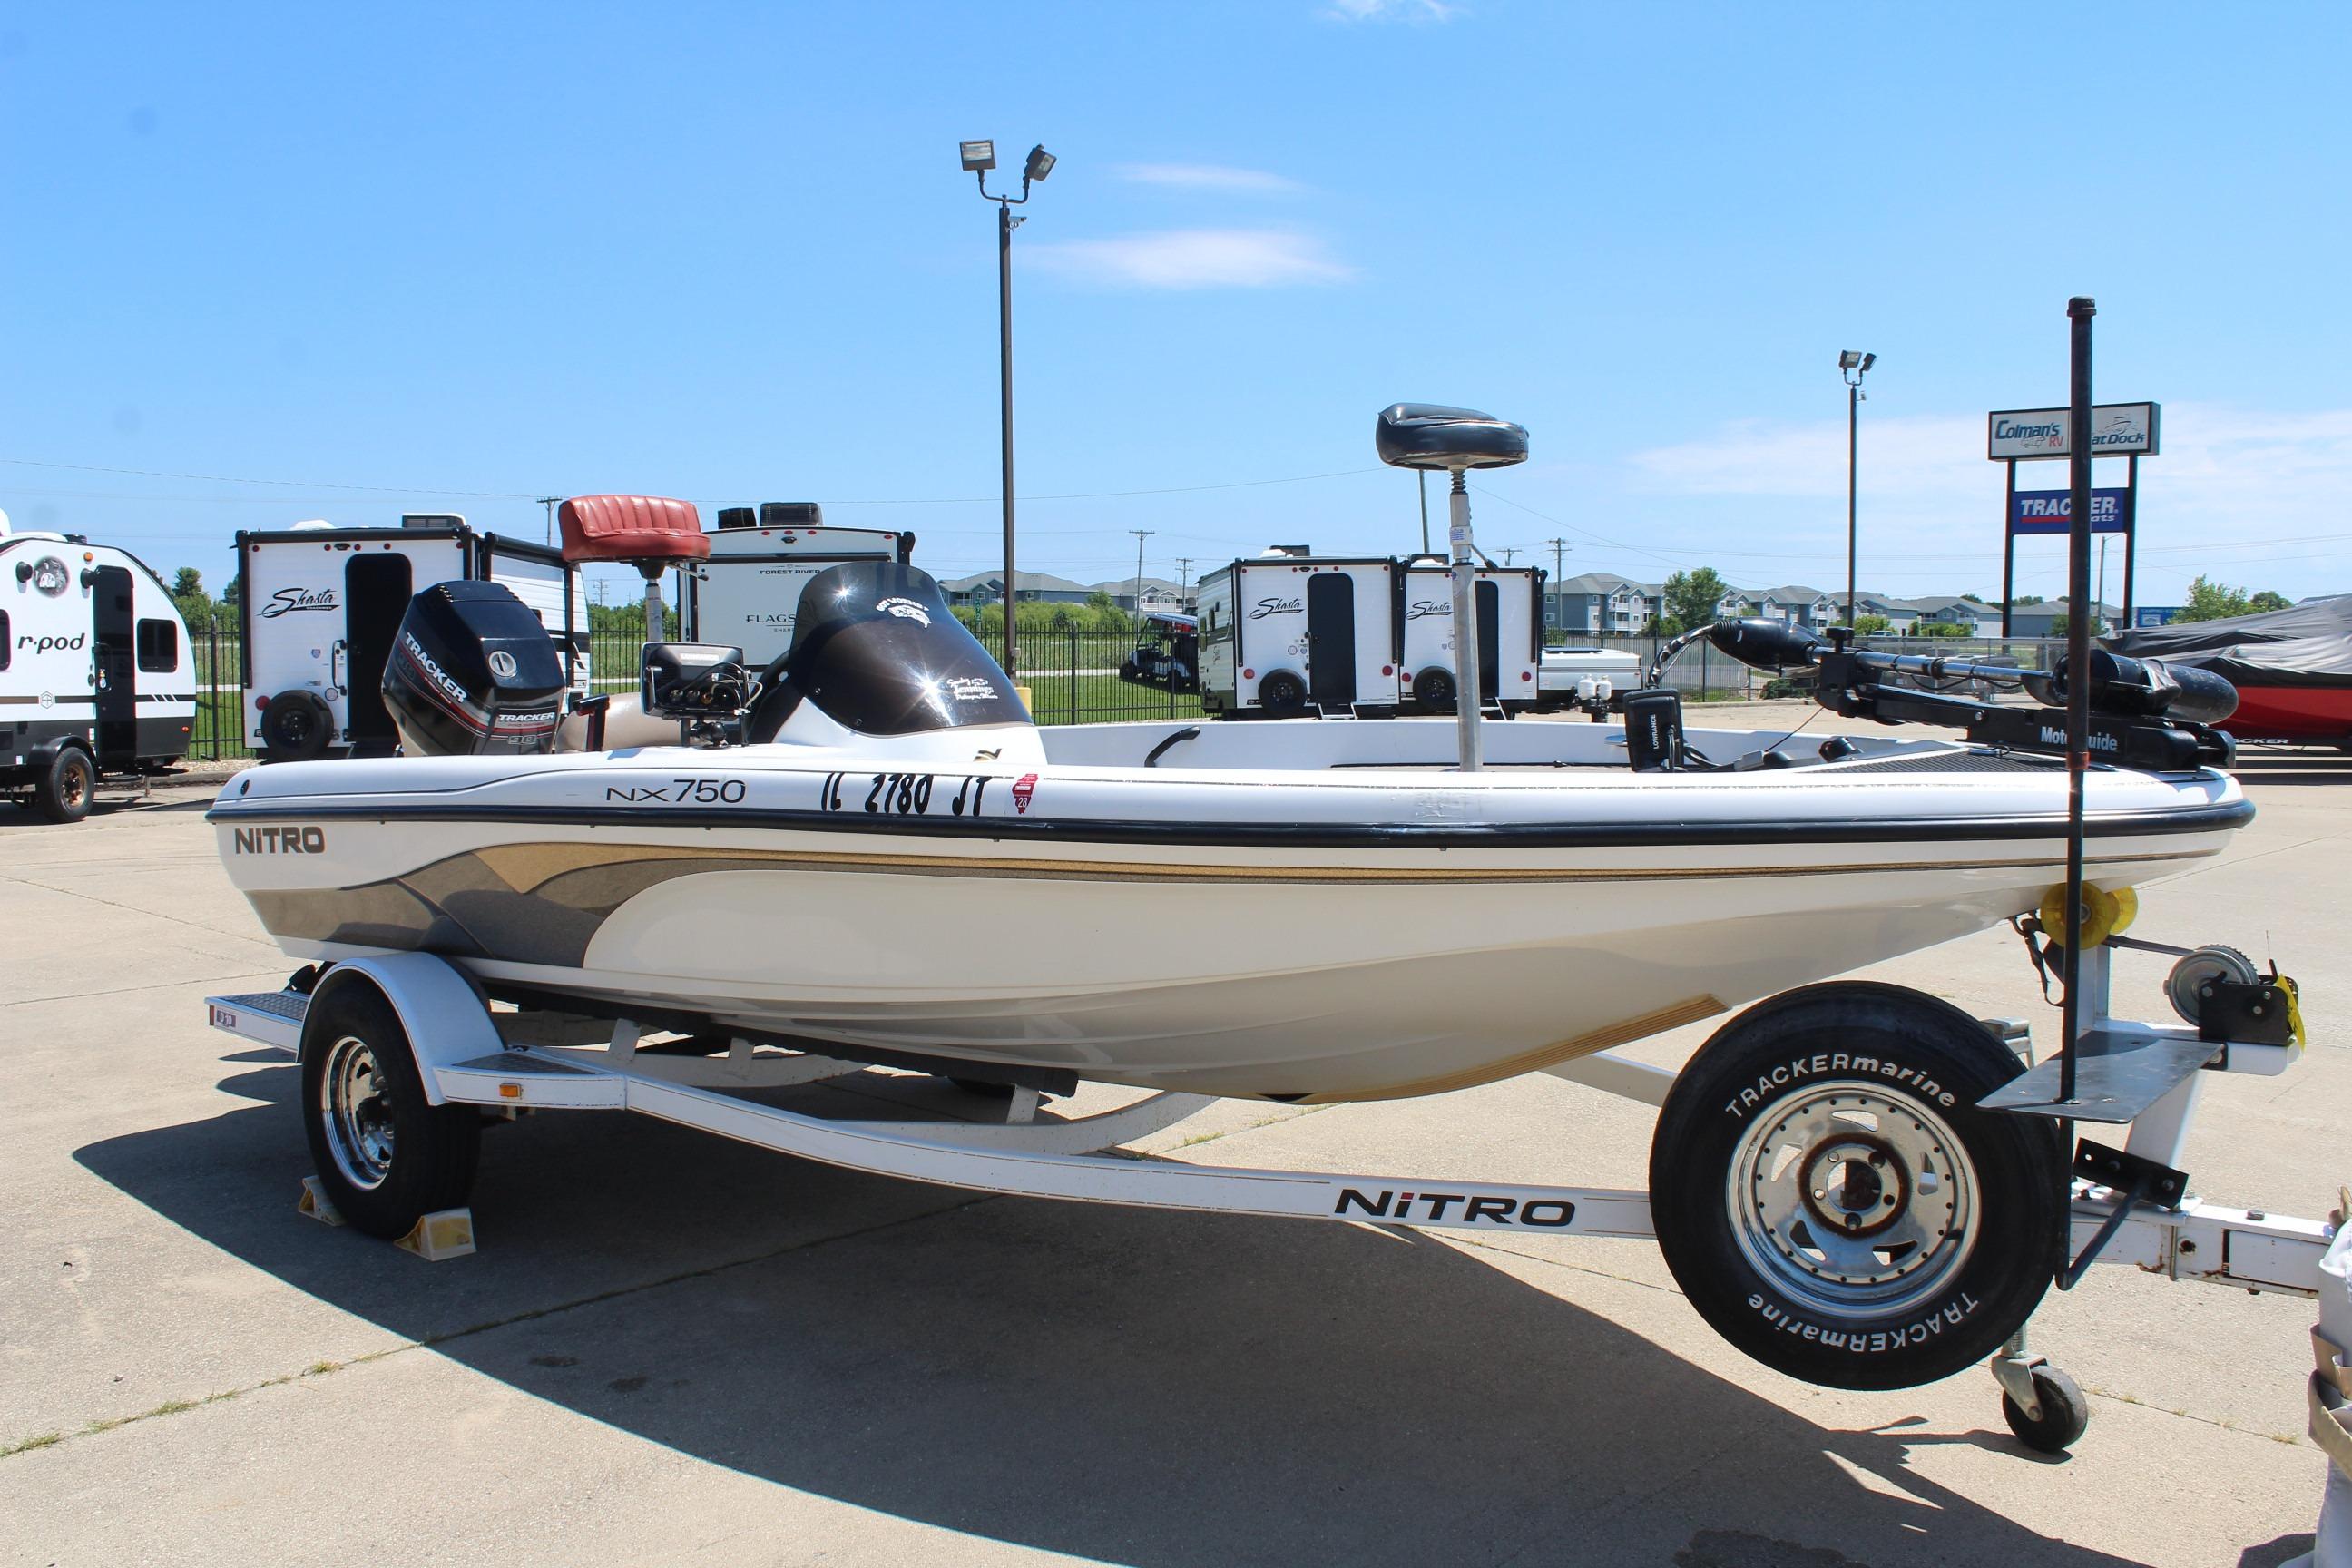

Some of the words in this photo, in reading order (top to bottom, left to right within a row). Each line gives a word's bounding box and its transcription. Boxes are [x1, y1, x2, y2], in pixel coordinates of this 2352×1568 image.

[1995, 420, 2061, 440] Colman's
[2107, 432, 2144, 444] Dock
[2048, 436, 2064, 447] RV
[2021, 496, 2116, 516] TRACER
[260, 587, 338, 619] Shasta
[1250, 597, 1301, 620] Shasta
[1406, 601, 1452, 621] Shasta
[746, 614, 797, 623] FLAGS
[406, 632, 467, 703] TRACKER
[498, 711, 556, 722] TRACKER
[1650, 713, 1660, 750] LOWRANCE
[2040, 725, 2119, 752] Motuide
[820, 771, 846, 812] IL
[864, 773, 935, 815] 2780
[951, 775, 993, 817] JT
